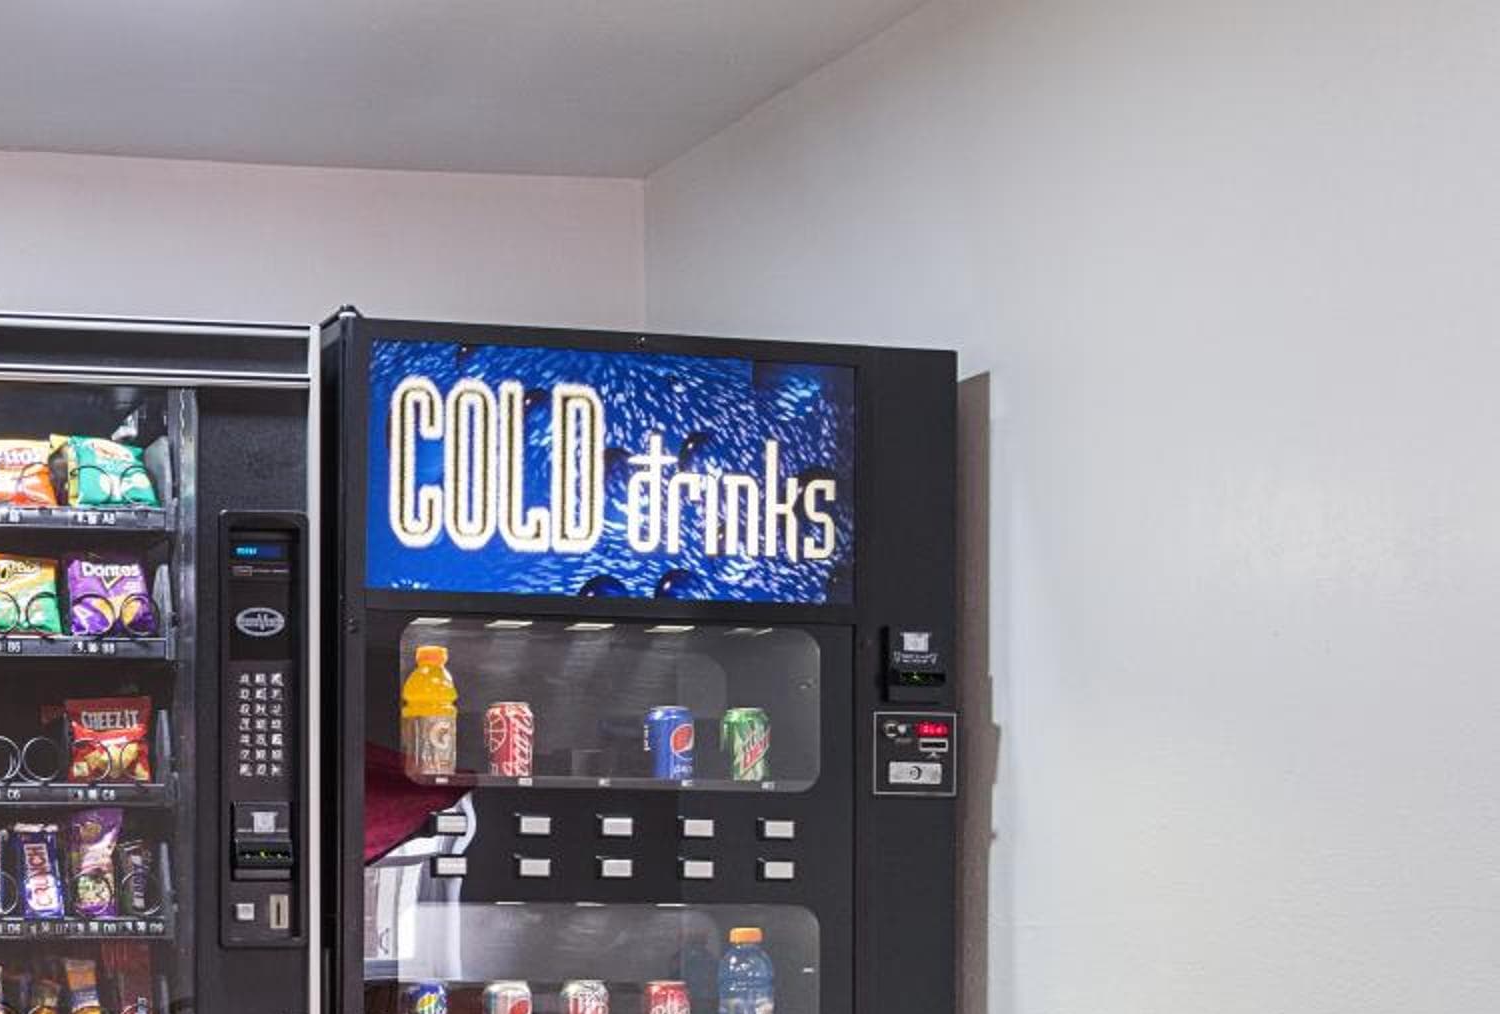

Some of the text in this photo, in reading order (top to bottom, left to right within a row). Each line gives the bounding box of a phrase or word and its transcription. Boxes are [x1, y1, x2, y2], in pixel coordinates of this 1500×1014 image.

[389, 375, 836, 563] COLD drinks
[82, 562, 140, 577] Doritos
